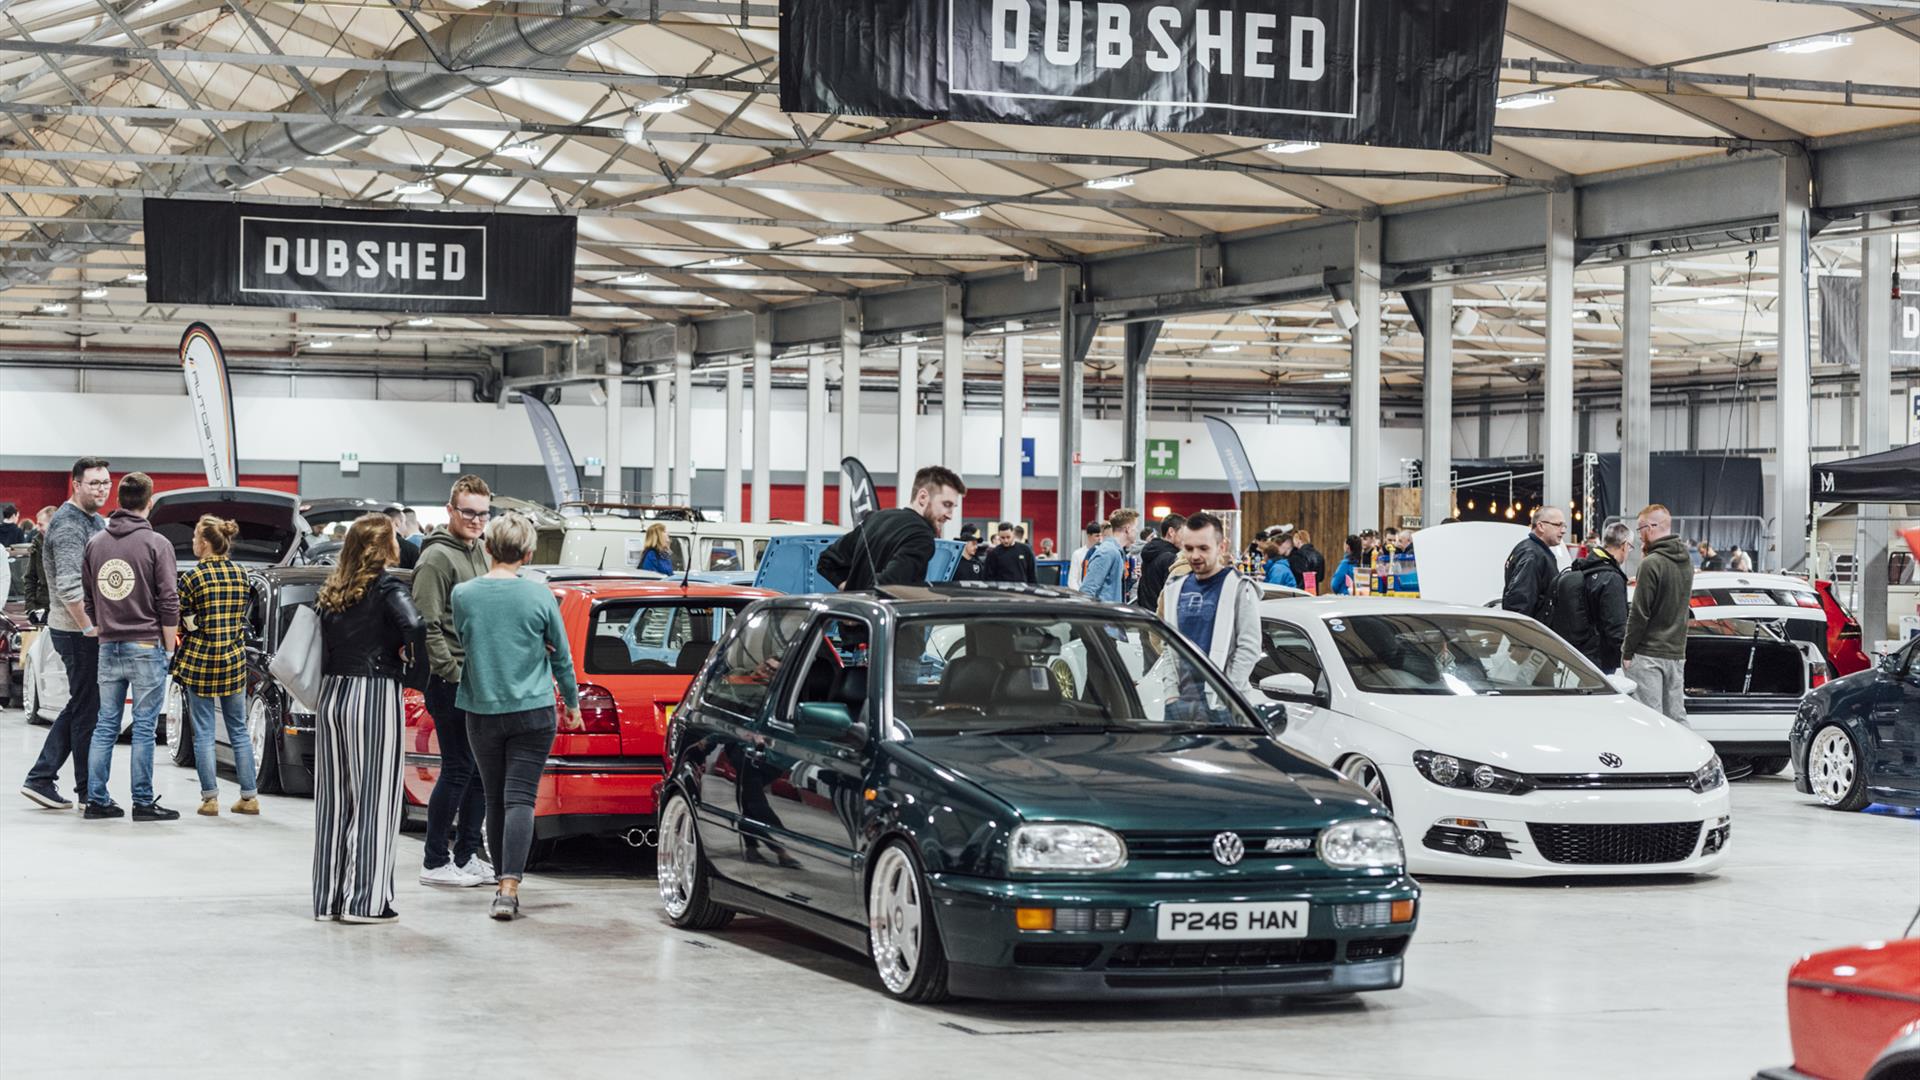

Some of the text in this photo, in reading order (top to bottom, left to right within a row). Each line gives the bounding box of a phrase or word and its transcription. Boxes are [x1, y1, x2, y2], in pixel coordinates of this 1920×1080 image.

[991, 0, 1326, 81] DUBSHED
[264, 236, 467, 282] DUBSHED
[1170, 911, 1298, 931] P246 HAN
